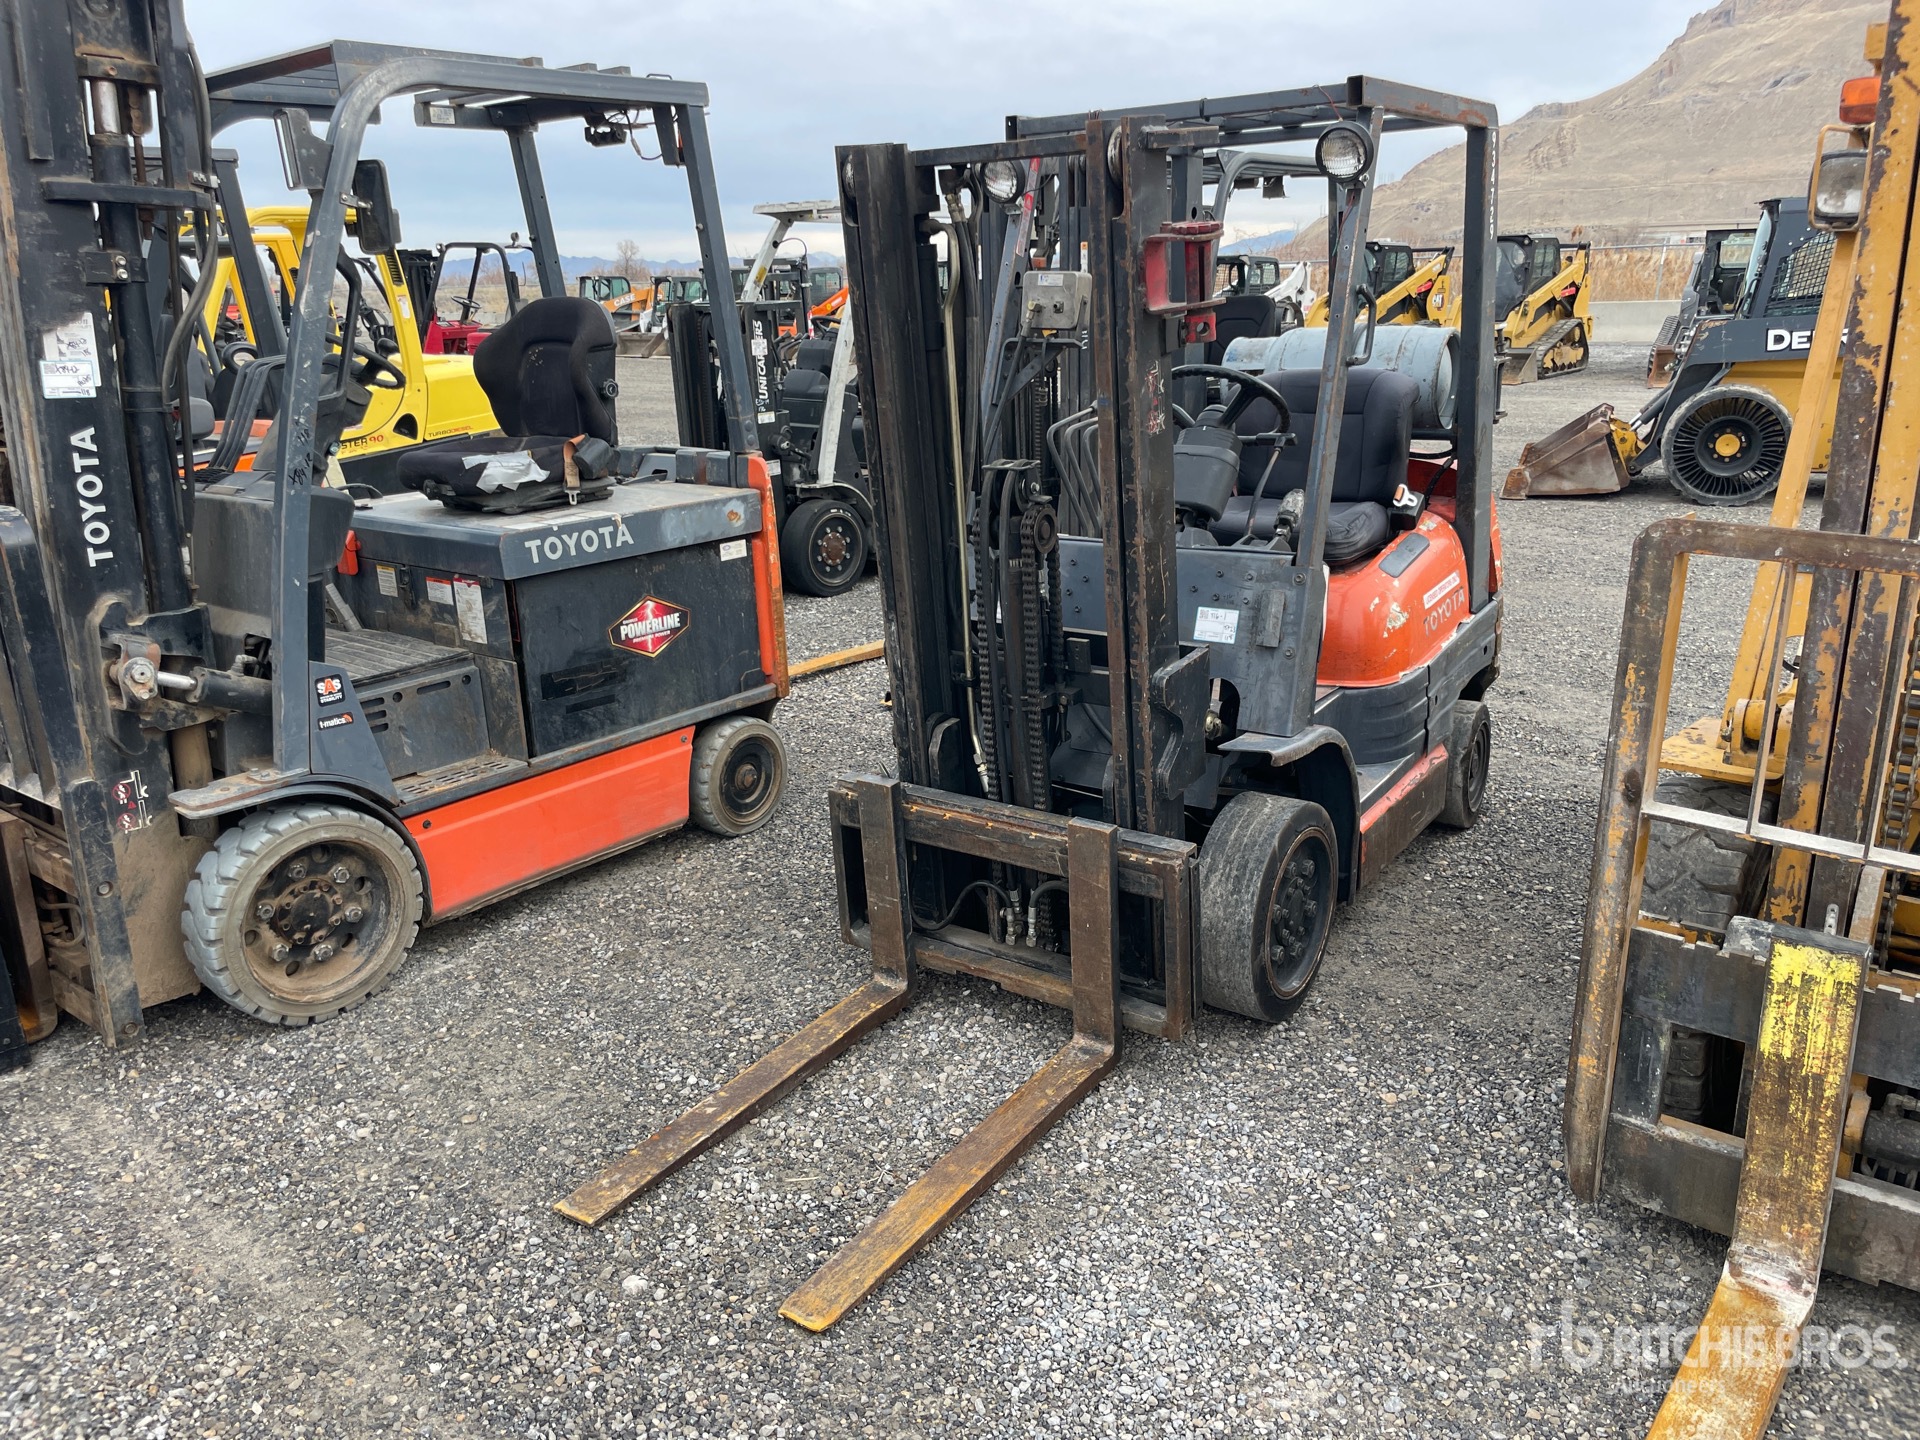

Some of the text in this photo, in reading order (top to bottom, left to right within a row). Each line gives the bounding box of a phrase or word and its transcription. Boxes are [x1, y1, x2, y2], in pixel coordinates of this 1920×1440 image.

[613, 294, 636, 307] CASE
[754, 320, 769, 400] UNICAERS
[341, 434, 384, 450] STER 90
[70, 426, 114, 568] TOYOTA
[524, 523, 635, 564] TOYOTA
[620, 612, 681, 641] POWERLINE
[1423, 586, 1465, 637] TOYOTA
[317, 678, 342, 695] SAS
